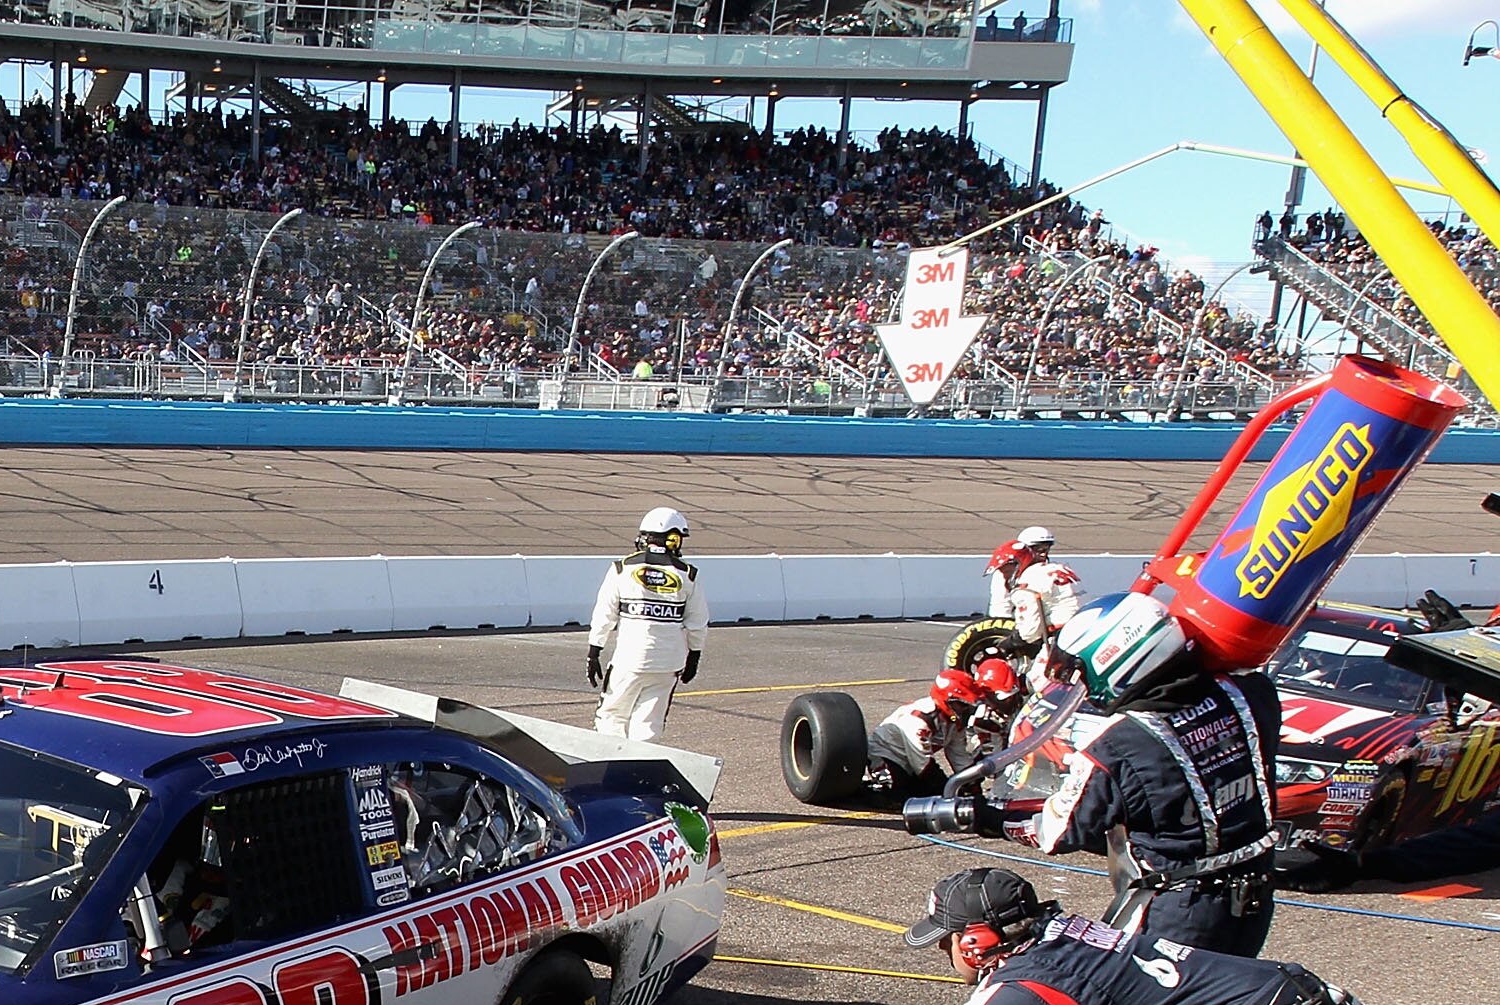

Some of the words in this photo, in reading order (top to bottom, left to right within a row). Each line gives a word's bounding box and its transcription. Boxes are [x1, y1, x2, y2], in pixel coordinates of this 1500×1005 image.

[916, 262, 955, 284] 3M
[911, 308, 949, 330] 3M
[905, 362, 943, 383] 3M
[1242, 430, 1368, 595] SUNOCO
[148, 568, 164, 595] 4
[628, 604, 681, 617] OFFICIAL
[359, 808, 393, 821] TOOLS
[361, 827, 396, 842] Purolator
[377, 872, 403, 884] SIEMENS
[382, 874, 566, 998] NATIONAL
[560, 830, 660, 927] GUARD
[83, 945, 116, 960] NASCAR
[61, 962, 96, 974] RACE
[97, 959, 122, 968] CAR
